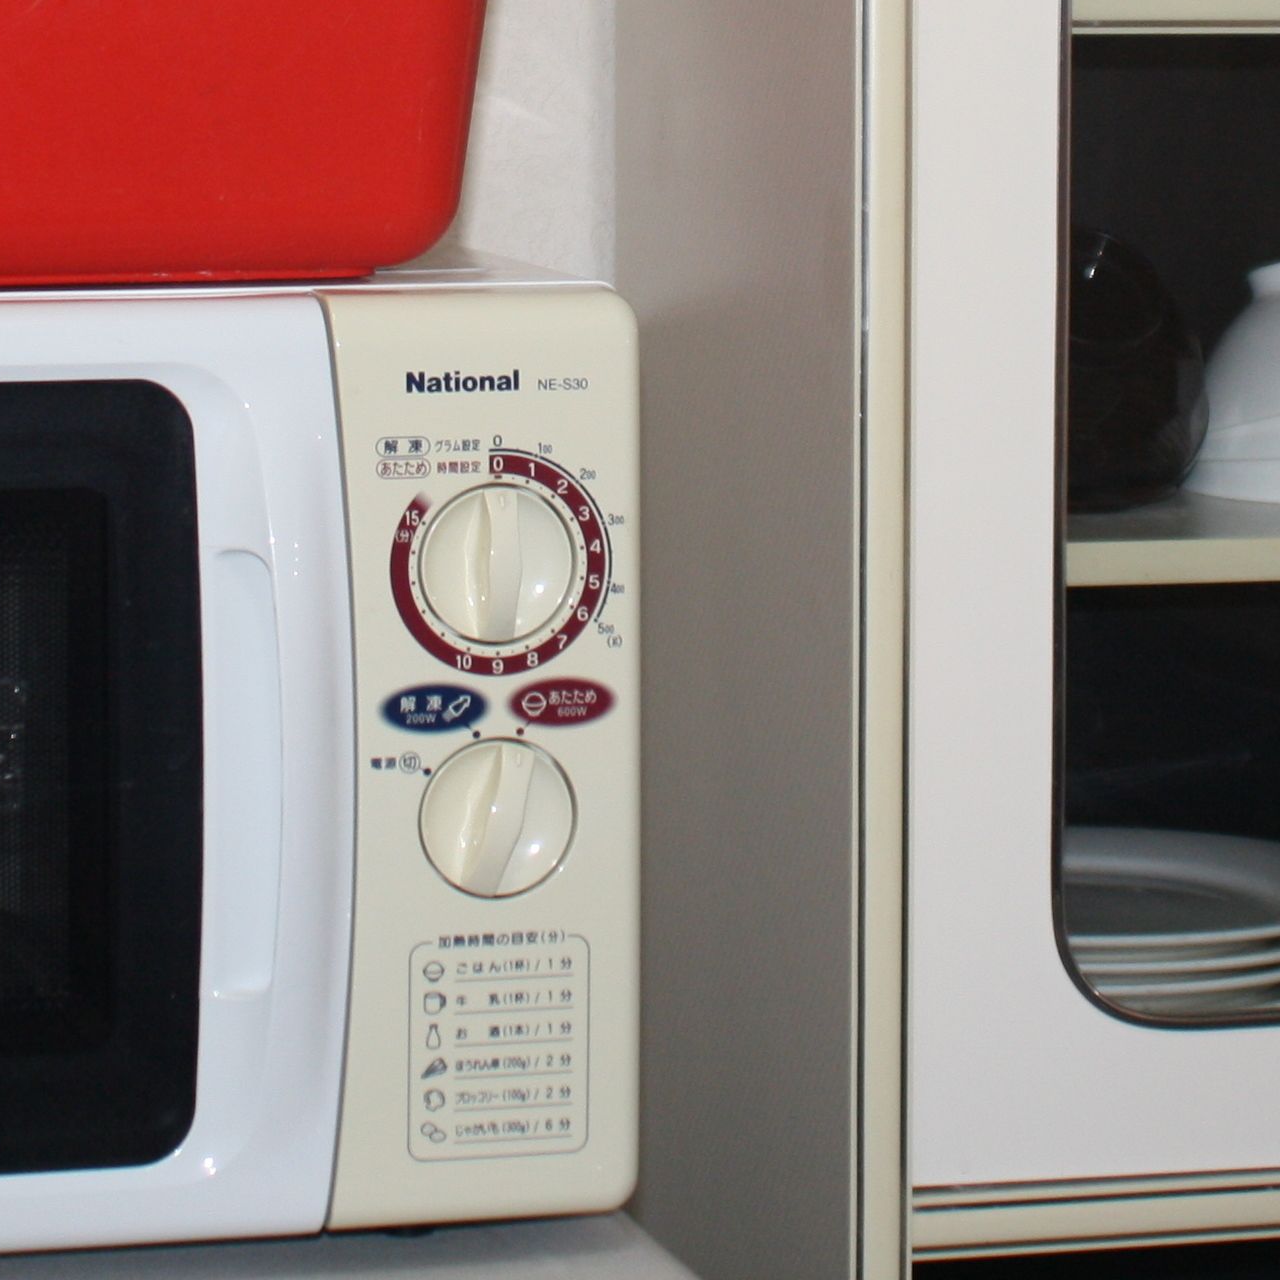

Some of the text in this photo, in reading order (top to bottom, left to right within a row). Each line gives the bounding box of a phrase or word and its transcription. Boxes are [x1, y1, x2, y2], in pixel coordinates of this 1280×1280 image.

[406, 369, 589, 393] National NE-S30
[434, 438, 481, 452] グラム設定
[537, 442, 553, 455] 100
[380, 460, 482, 476] あたため 時間設定
[493, 455, 504, 471] 0
[528, 462, 536, 477] 1
[579, 467, 597, 480] 200
[556, 479, 568, 494] 2
[405, 510, 420, 526] 15
[579, 506, 590, 521] 3
[607, 513, 625, 526] 300
[590, 539, 601, 554] 4
[589, 574, 600, 589] 5
[609, 582, 625, 594] 400
[576, 606, 588, 621] 6
[597, 622, 615, 635] 500
[557, 634, 568, 650] 7
[455, 653, 472, 669] 10
[492, 658, 504, 674] 9
[527, 651, 538, 667] 8
[548, 690, 598, 705] あたため
[405, 711, 437, 724] 200W
[557, 705, 588, 718] 600W
[438, 930, 566, 949] 加熱時間の目安(分)
